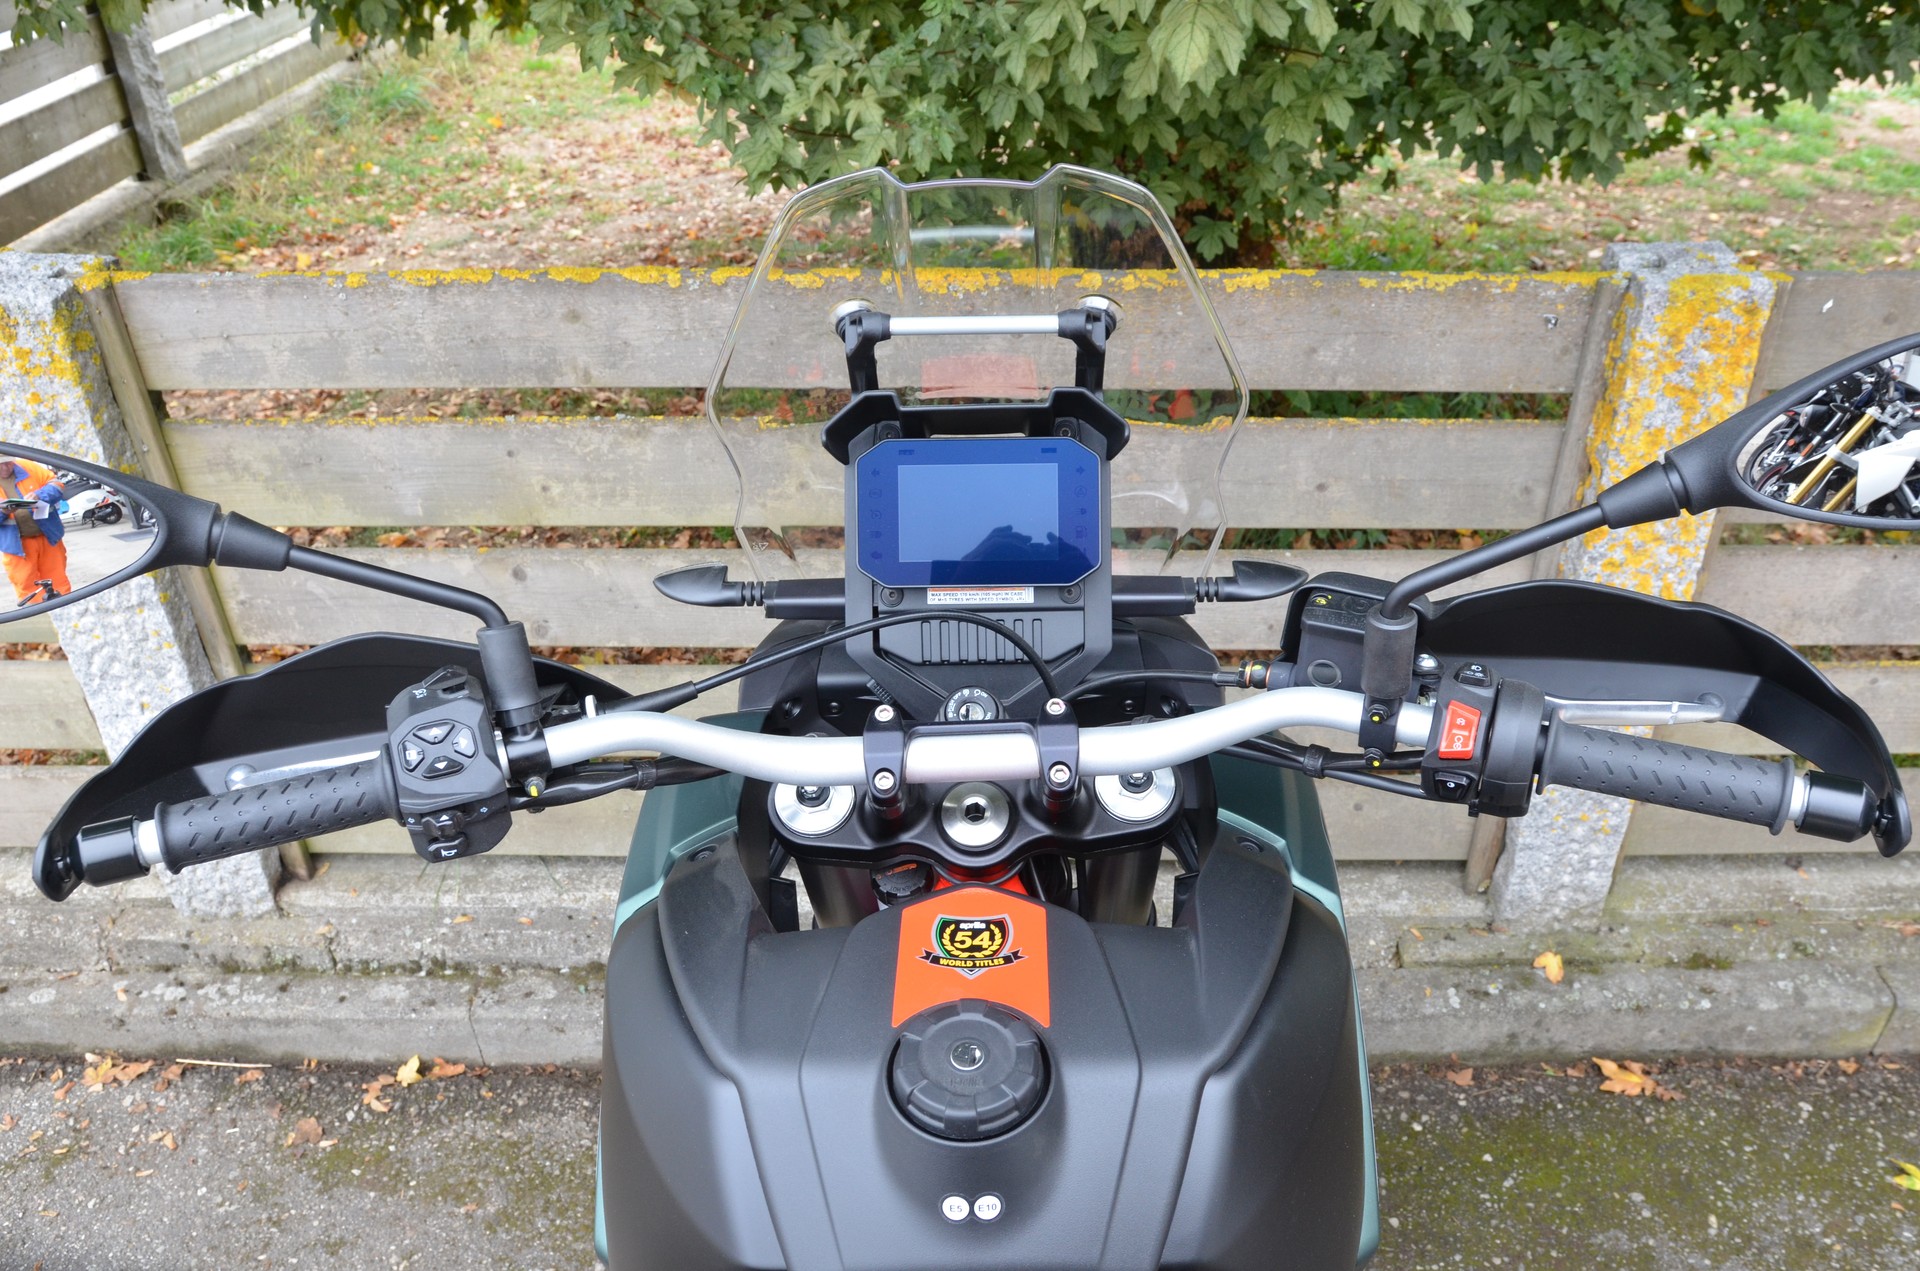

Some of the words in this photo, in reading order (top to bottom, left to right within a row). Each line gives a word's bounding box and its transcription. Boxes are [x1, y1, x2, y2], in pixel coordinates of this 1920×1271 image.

[959, 921, 986, 930] aprilia
[953, 931, 992, 949] 54
[939, 958, 973, 967] WORLD
[975, 957, 1005, 967] TITLES
[949, 1204, 963, 1213] E5
[978, 1203, 998, 1212] E10
